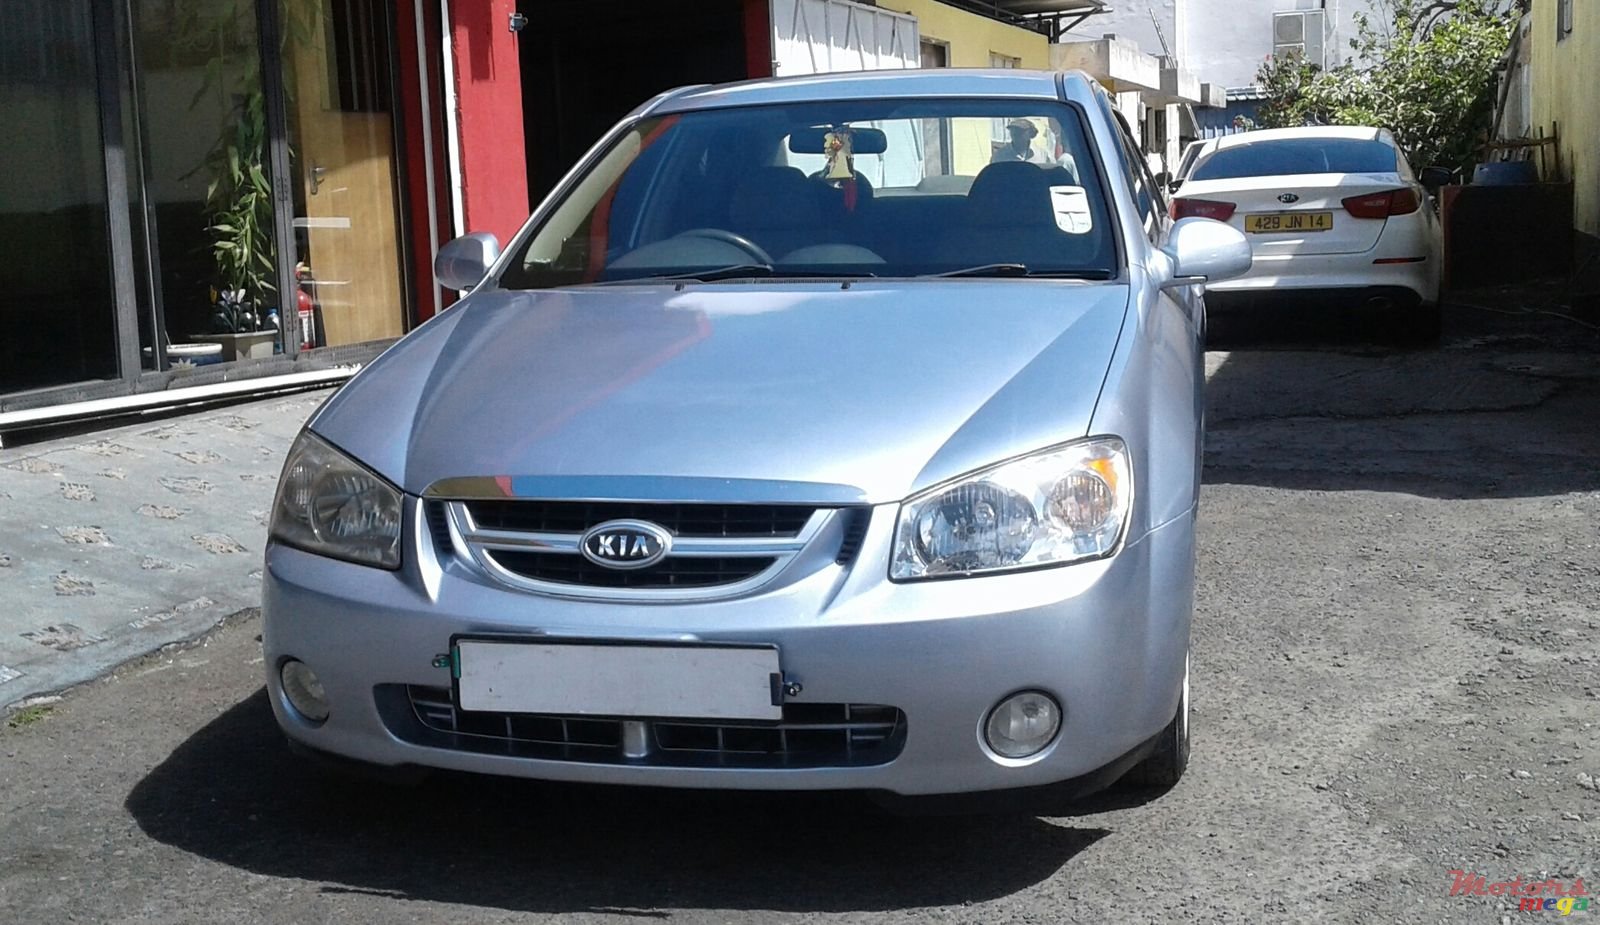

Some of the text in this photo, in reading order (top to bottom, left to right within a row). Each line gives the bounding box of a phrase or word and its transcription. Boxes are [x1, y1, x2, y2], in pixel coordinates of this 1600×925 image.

[1285, 215, 1302, 228] JN
[1310, 215, 1323, 227] 14
[598, 534, 649, 556] KIA
